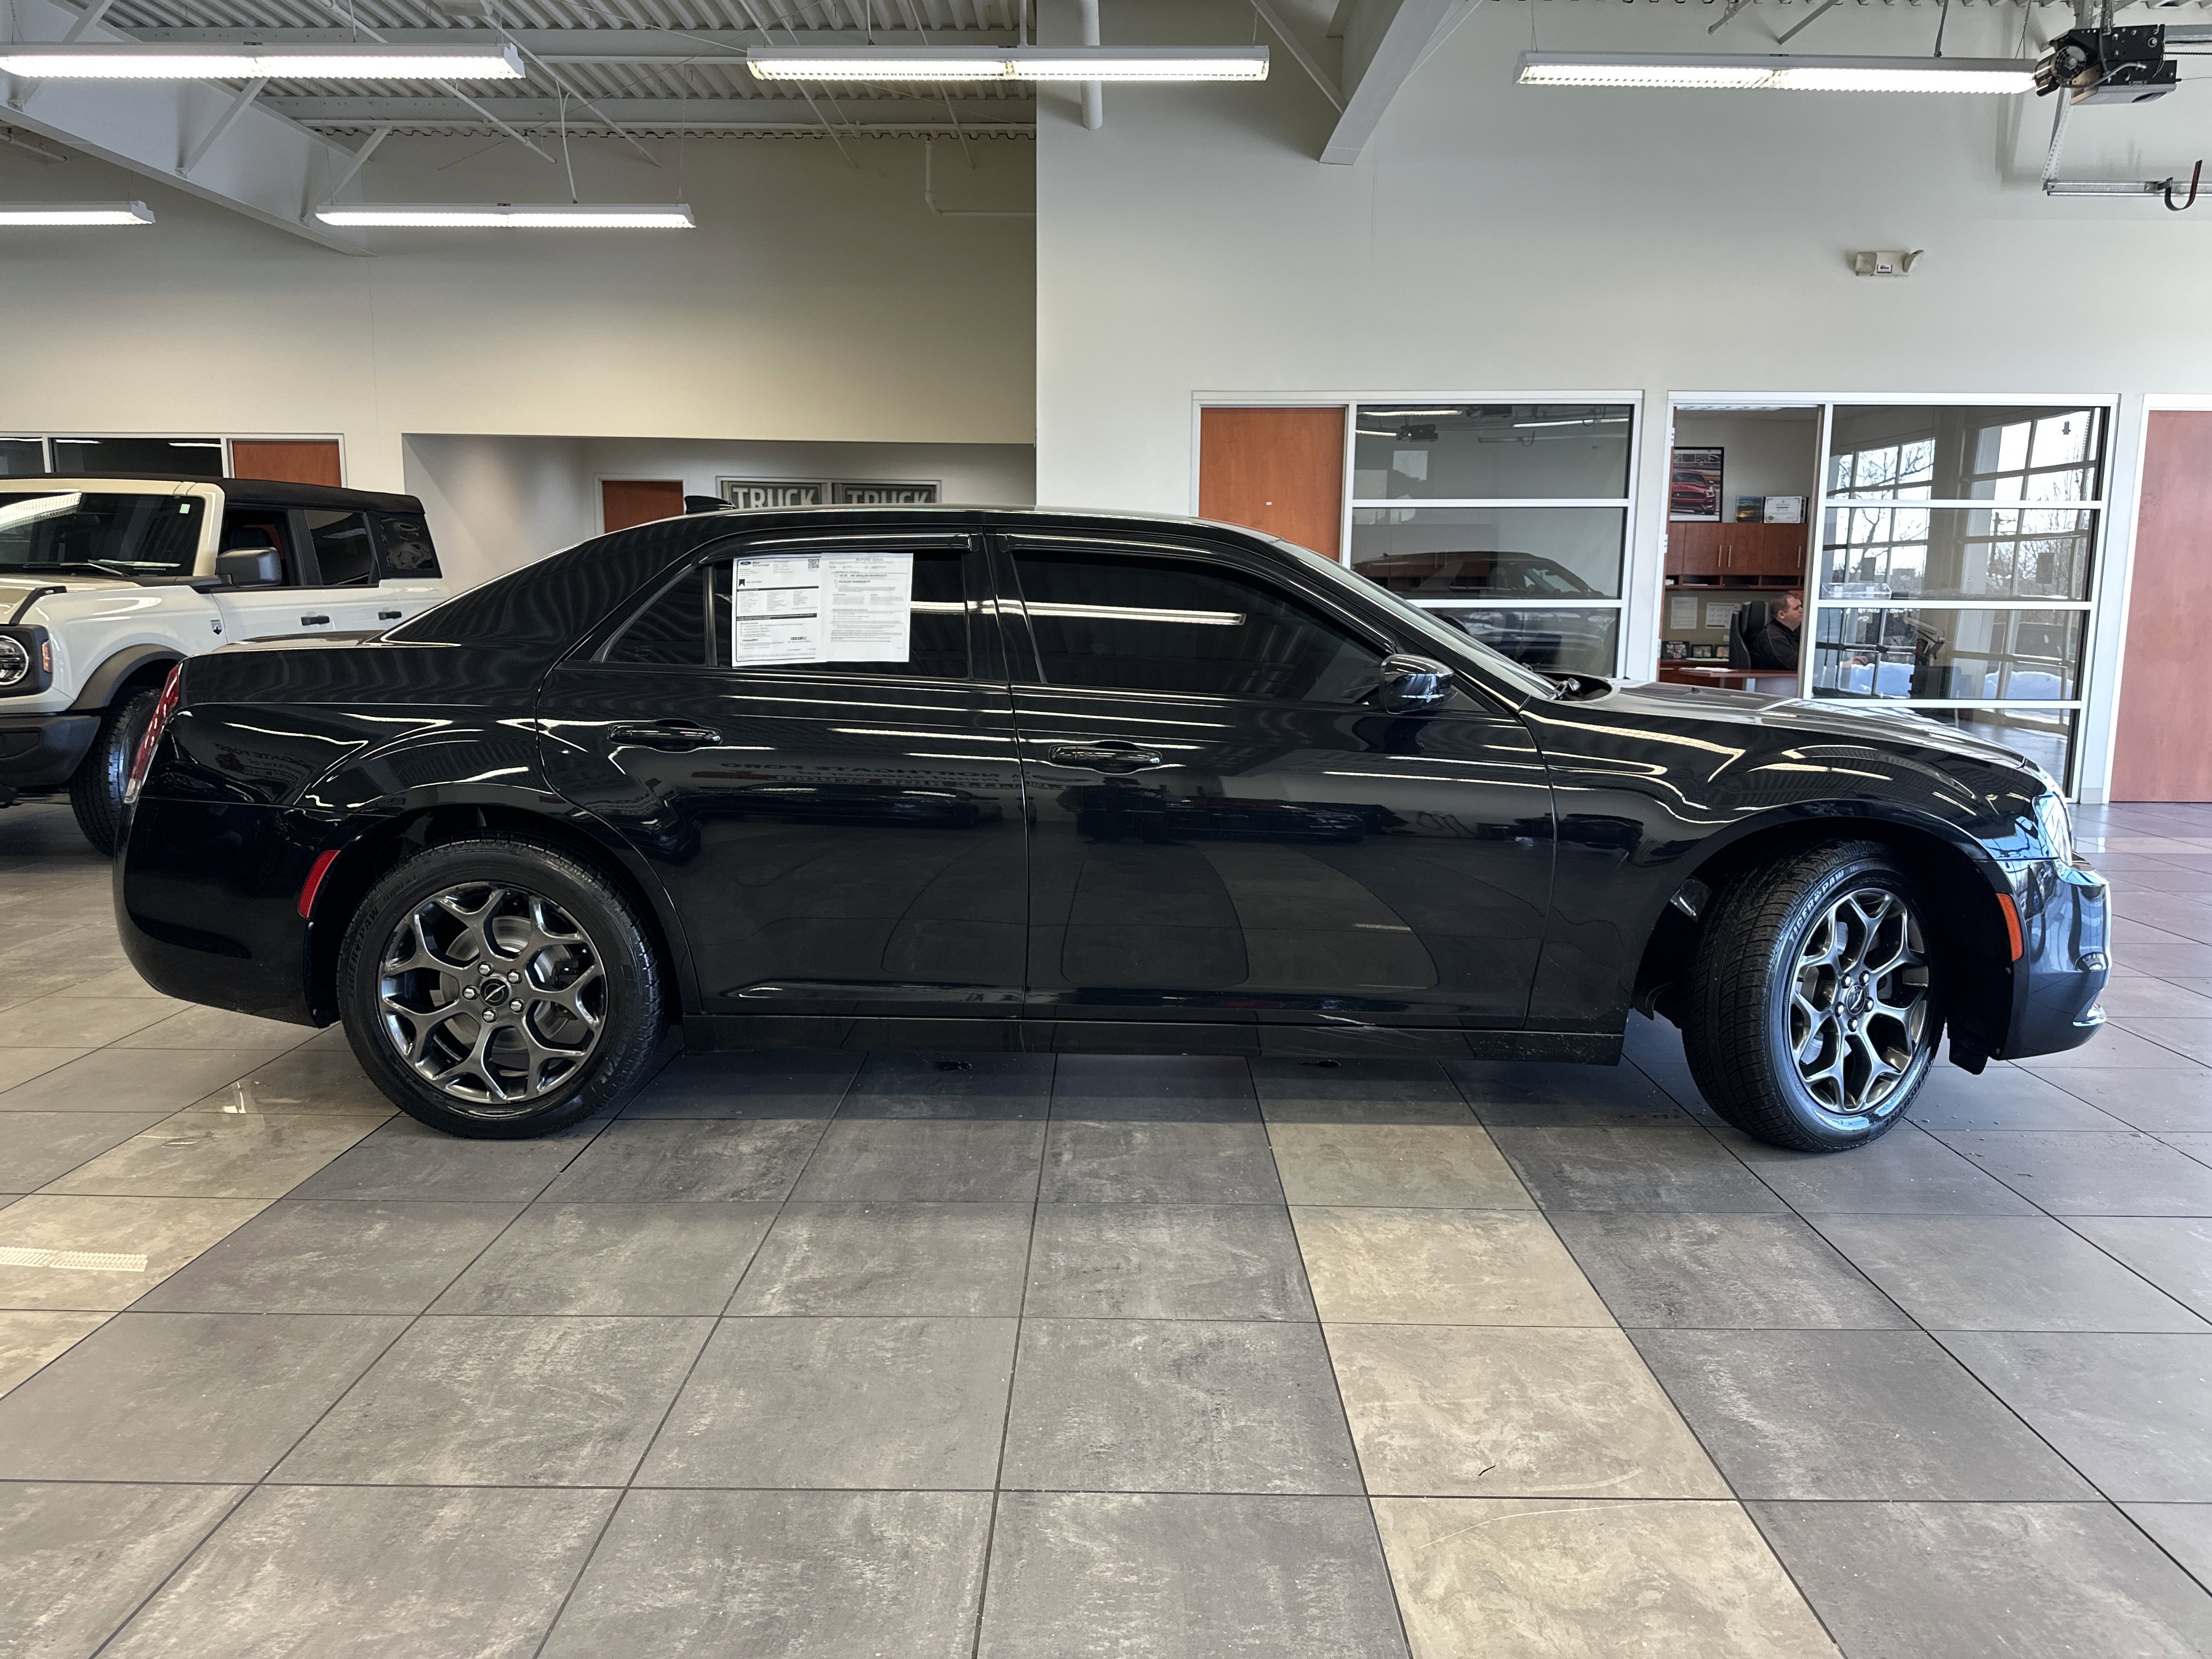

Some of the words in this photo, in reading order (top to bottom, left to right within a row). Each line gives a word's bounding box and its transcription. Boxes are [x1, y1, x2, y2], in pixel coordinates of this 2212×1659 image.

[732, 487, 816, 509] TRUCK
[1789, 899, 1815, 943] TIGER
[1821, 870, 1844, 894] PAW
[347, 950, 359, 1001] TIGER
[358, 906, 380, 939] PAW
